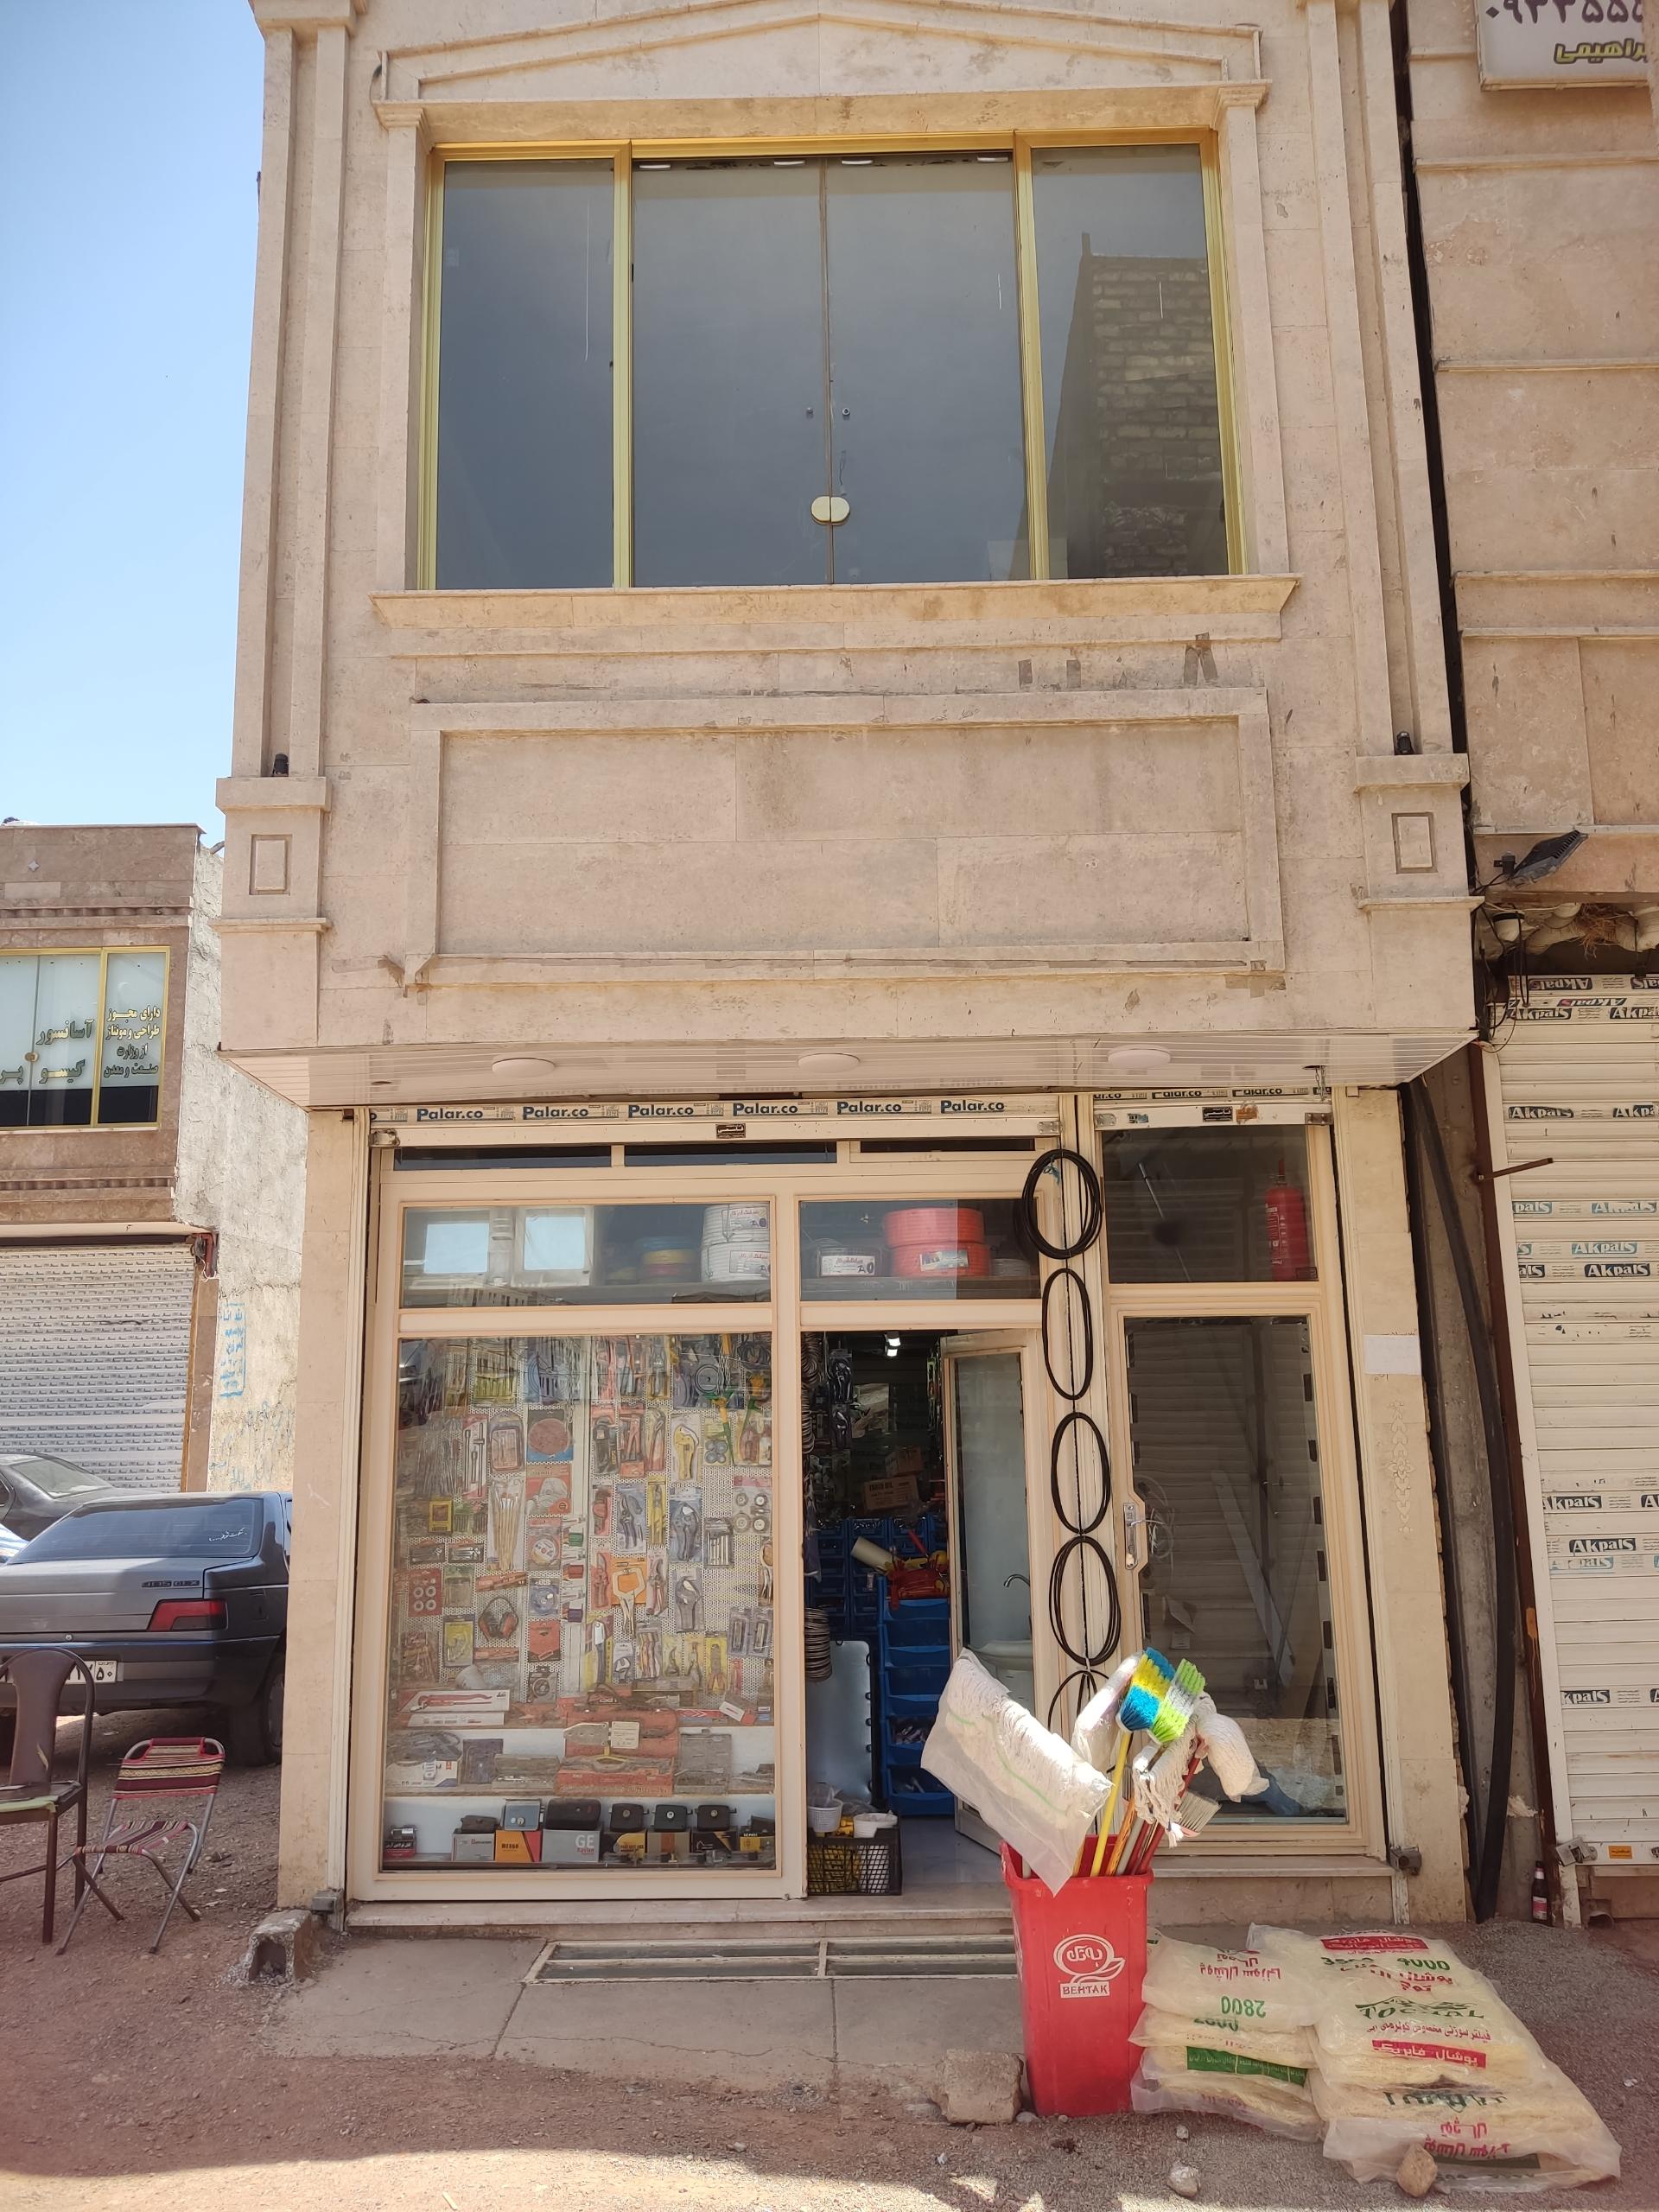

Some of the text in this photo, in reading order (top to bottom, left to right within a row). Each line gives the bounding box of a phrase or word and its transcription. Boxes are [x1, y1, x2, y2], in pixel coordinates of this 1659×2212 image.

[107, 1006, 161, 1023] دارای مجوز
[35, 1019, 94, 1046] آسانسور
[134, 1024, 161, 1040] طراحی
[117, 1043, 149, 1060] از وزارت
[39, 1059, 86, 1084] گیسو
[104, 1065, 124, 1078] معدن
[130, 1062, 159, 1075] صنعت
[628, 1104, 694, 1118] Palar.co
[733, 1103, 798, 1116] Palar.co
[837, 1101, 902, 1114] Palar.co
[940, 1099, 1005, 1112] Palar.co
[416, 1108, 483, 1122] Palar.co
[522, 1106, 588, 1120] Palar.co
[96, 1667, 112, 1680] ۵۰
[575, 1834, 594, 1847] GE
[1199, 1962, 1281, 1983] پوشال سوزنی
[1062, 1985, 1109, 1995] BEHTAK
[1220, 1995, 1267, 2018] 2800
[1373, 2043, 1478, 2068] پوشال فابریک
[1440, 2117, 1488, 2139] توچال
